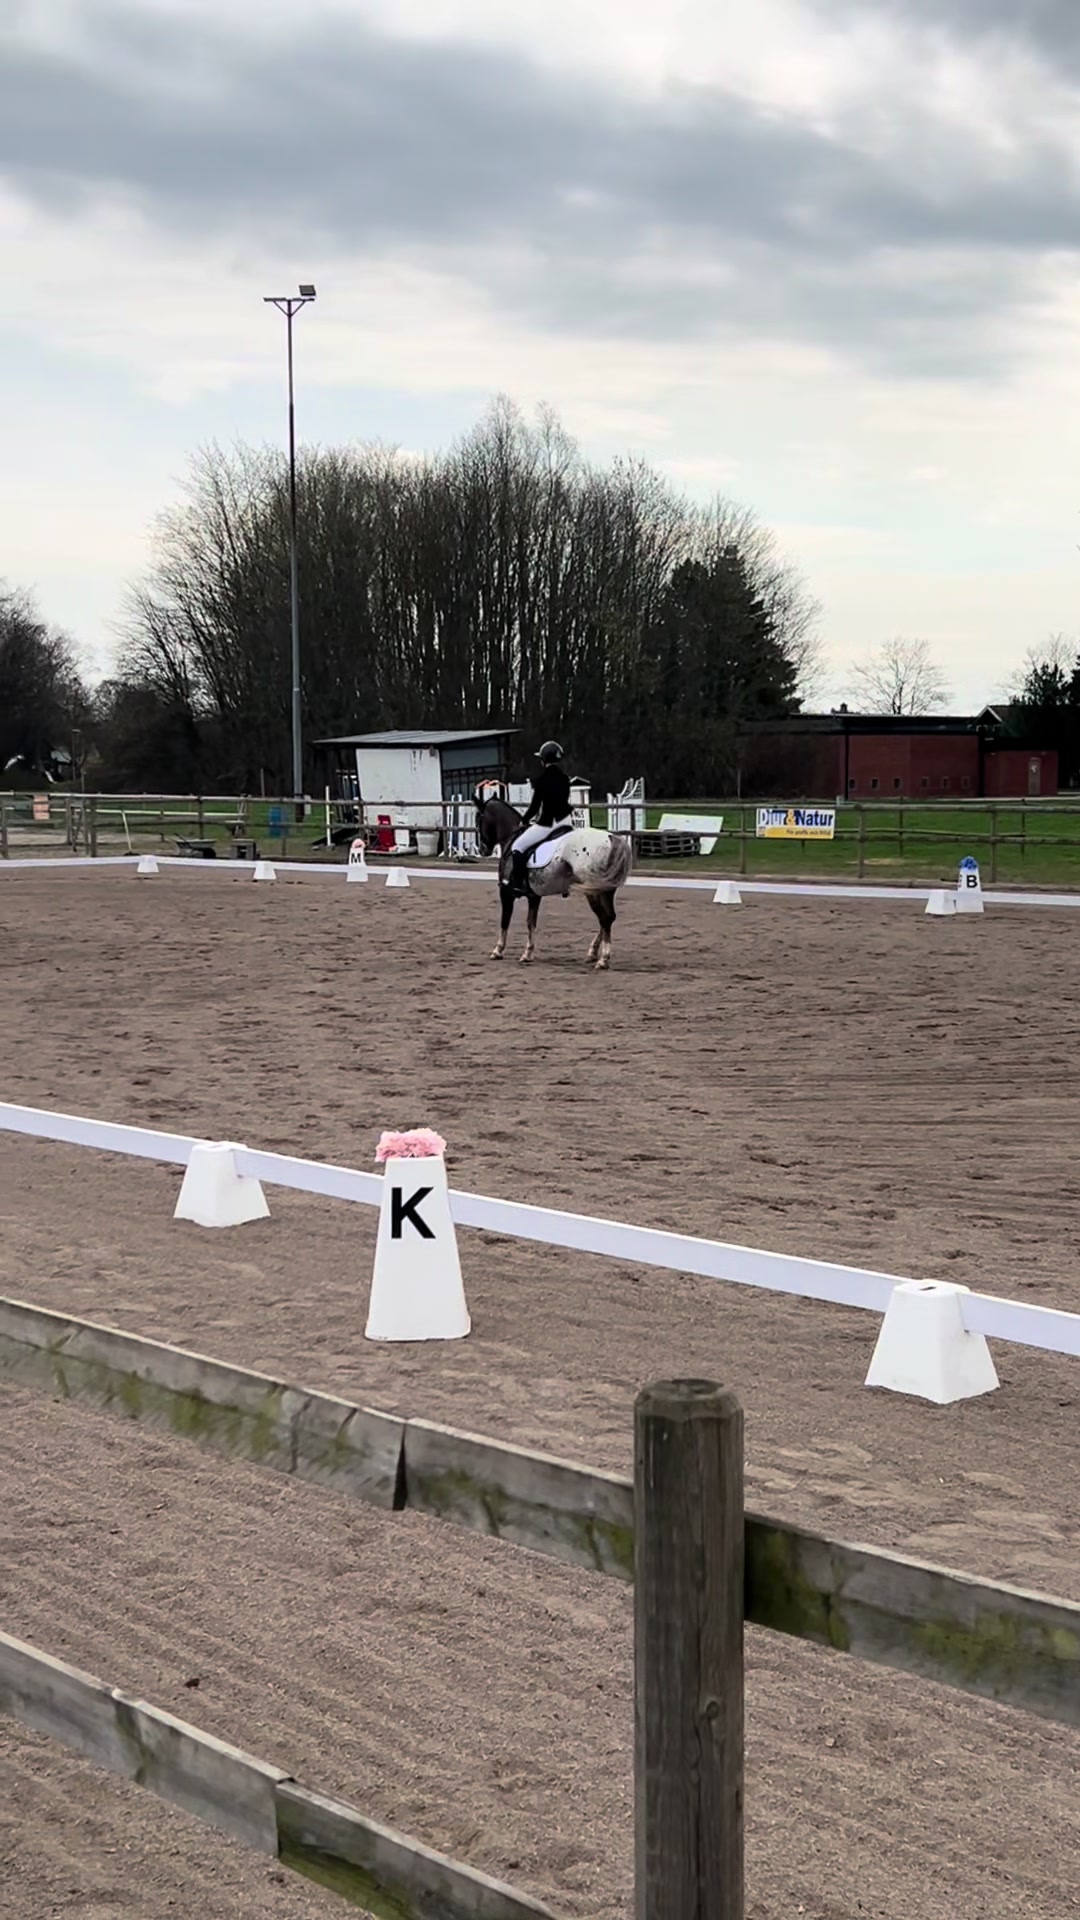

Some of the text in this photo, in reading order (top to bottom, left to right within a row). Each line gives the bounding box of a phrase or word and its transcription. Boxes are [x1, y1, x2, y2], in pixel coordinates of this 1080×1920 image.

[351, 853, 361, 864] M
[966, 875, 978, 888] B
[391, 1187, 436, 1239] K
